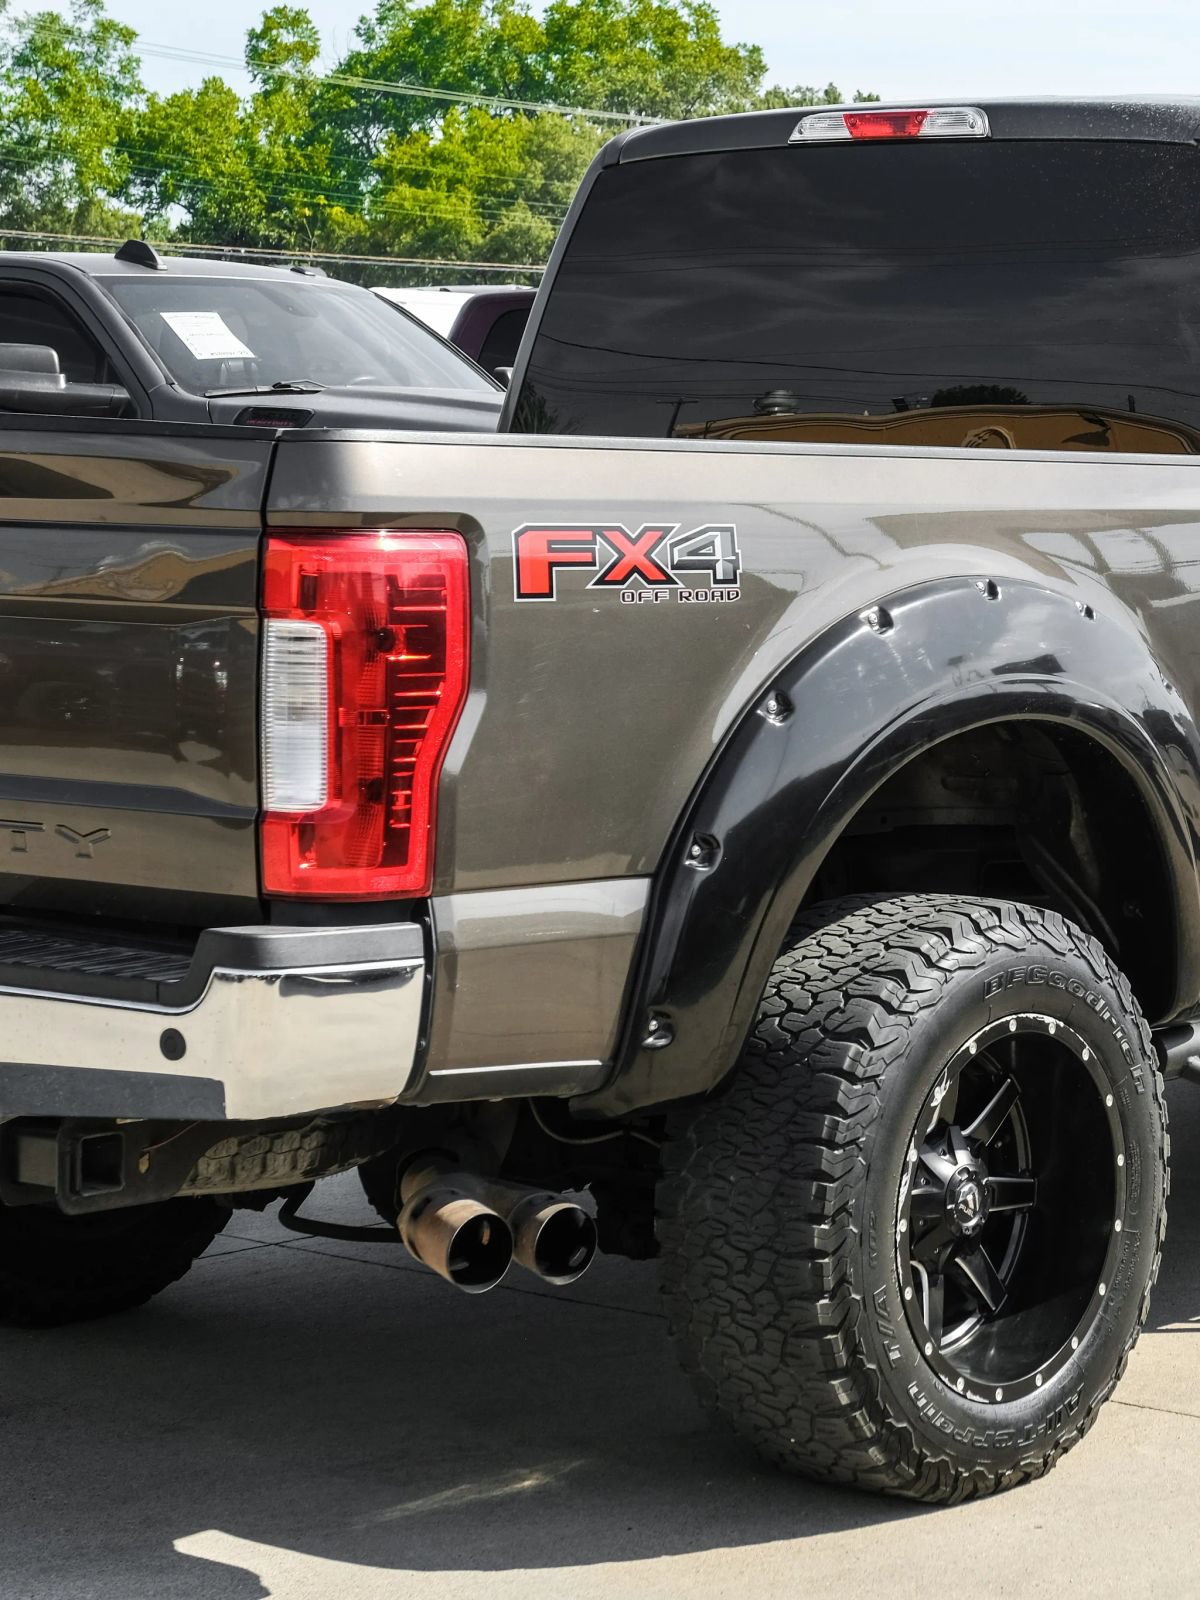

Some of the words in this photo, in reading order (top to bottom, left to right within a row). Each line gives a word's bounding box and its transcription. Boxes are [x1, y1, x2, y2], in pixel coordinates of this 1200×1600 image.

[512, 523, 742, 601] FX4
[620, 589, 670, 603] OFF
[678, 588, 741, 603] ROAD
